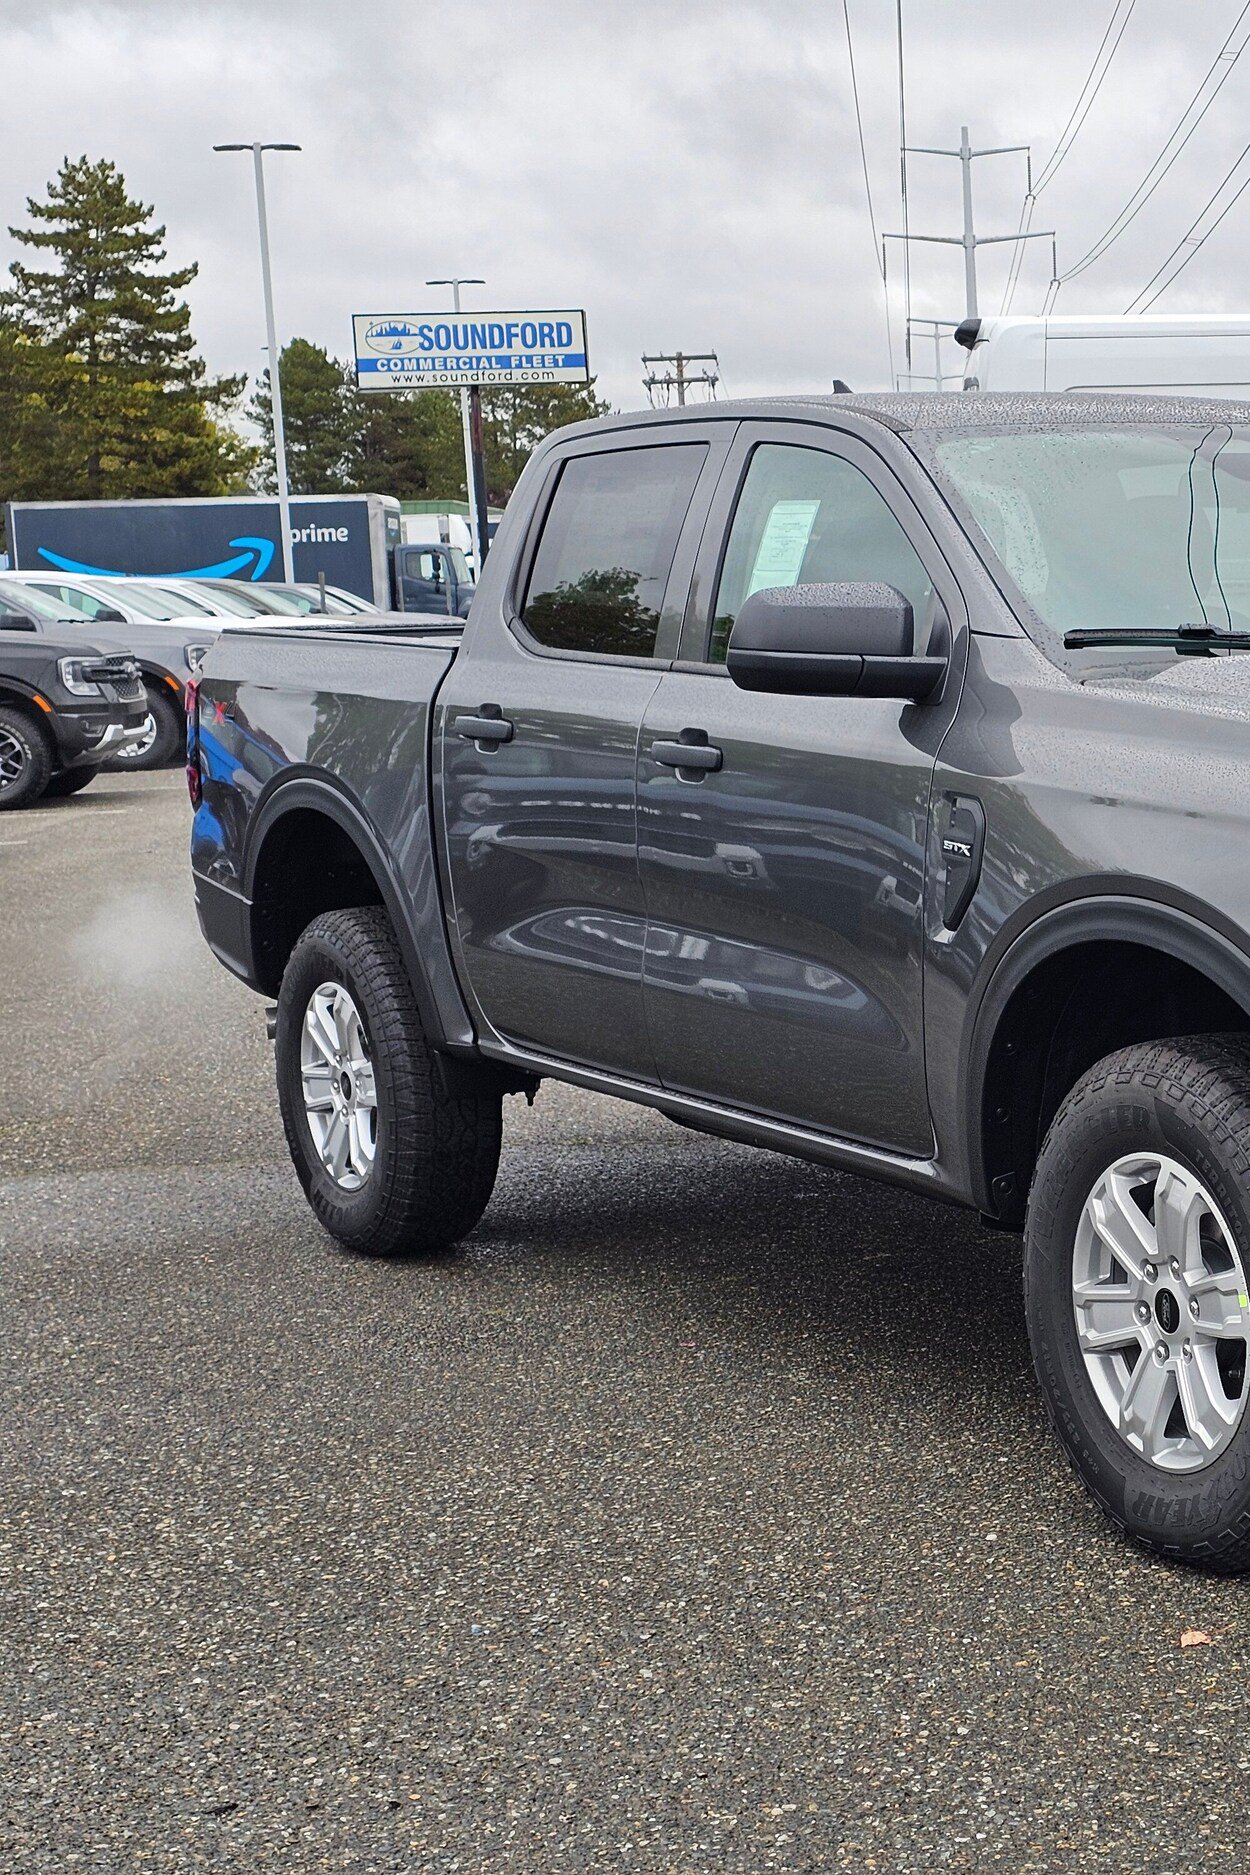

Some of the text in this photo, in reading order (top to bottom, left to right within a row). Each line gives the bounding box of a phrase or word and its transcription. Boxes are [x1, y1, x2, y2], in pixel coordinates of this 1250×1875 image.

[418, 321, 573, 351] SOUNDFORD
[376, 354, 566, 373] COMMERCIAL FLEET
[391, 369, 555, 384] www.soundford.com
[290, 523, 349, 547] prime
[943, 840, 971, 857] STX
